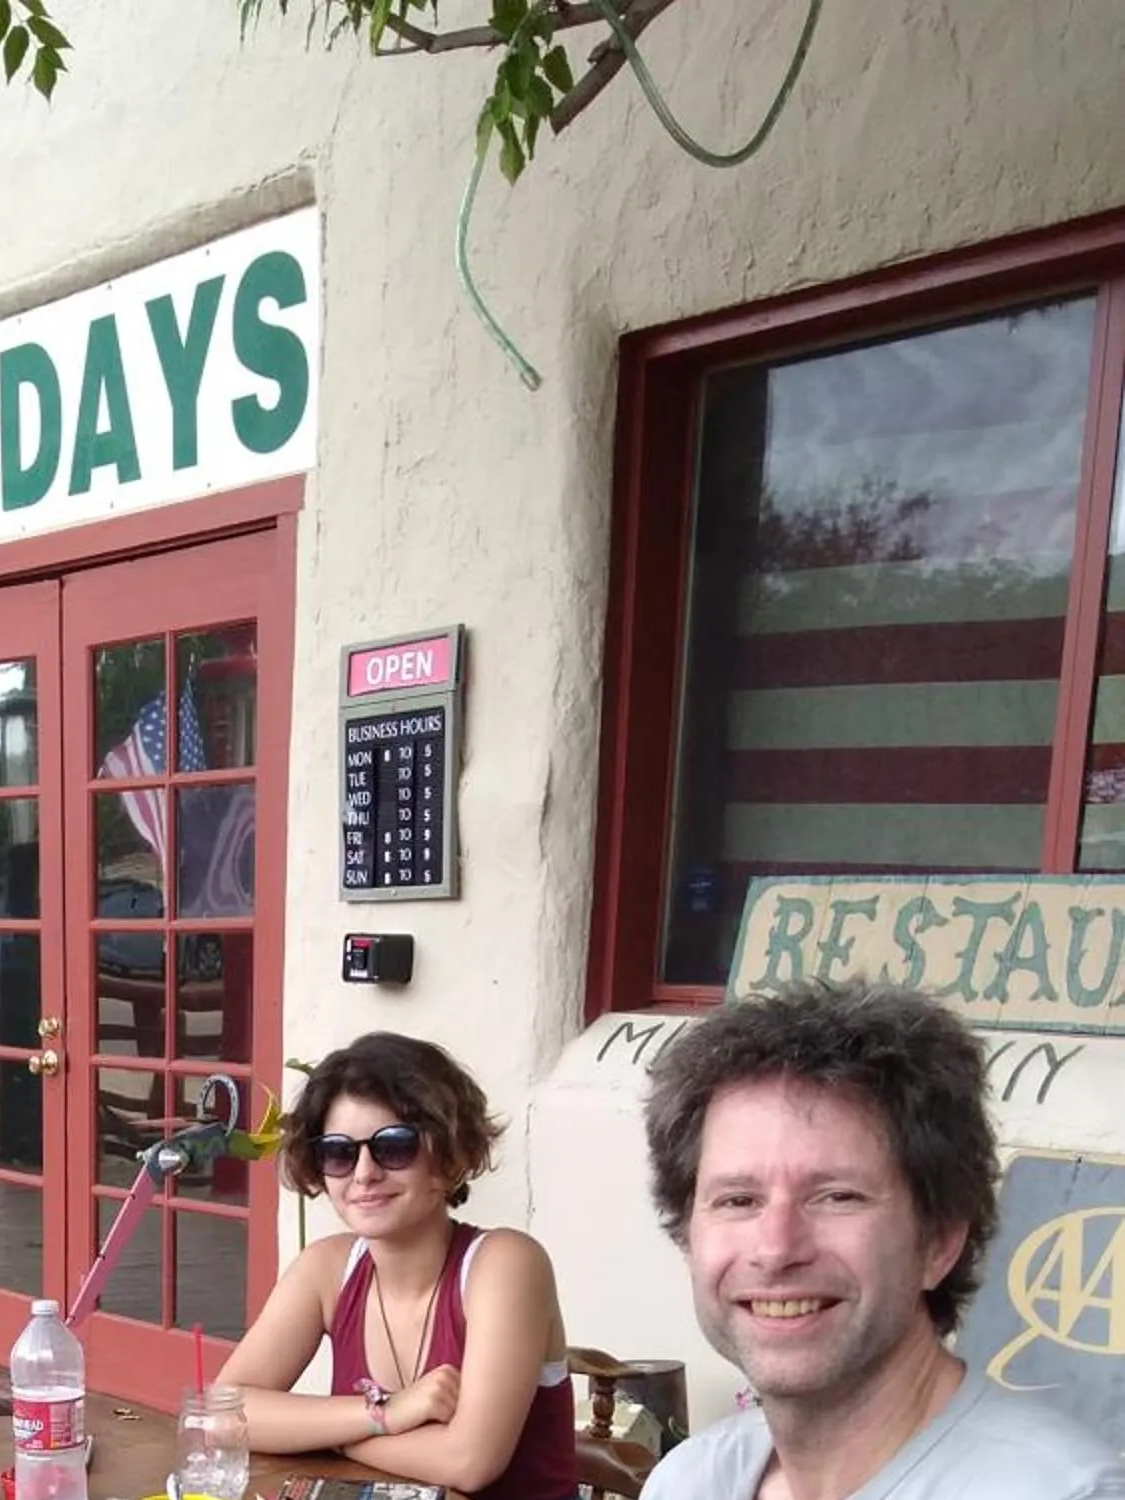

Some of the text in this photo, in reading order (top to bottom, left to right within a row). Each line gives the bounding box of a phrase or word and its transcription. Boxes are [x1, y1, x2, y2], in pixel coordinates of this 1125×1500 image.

[366, 649, 433, 685] OPEN
[348, 715, 442, 743] BUSINESS HOURS
[348, 750, 372, 766] MON
[348, 771, 366, 787] TUE
[750, 891, 1125, 1008] RESTAU
